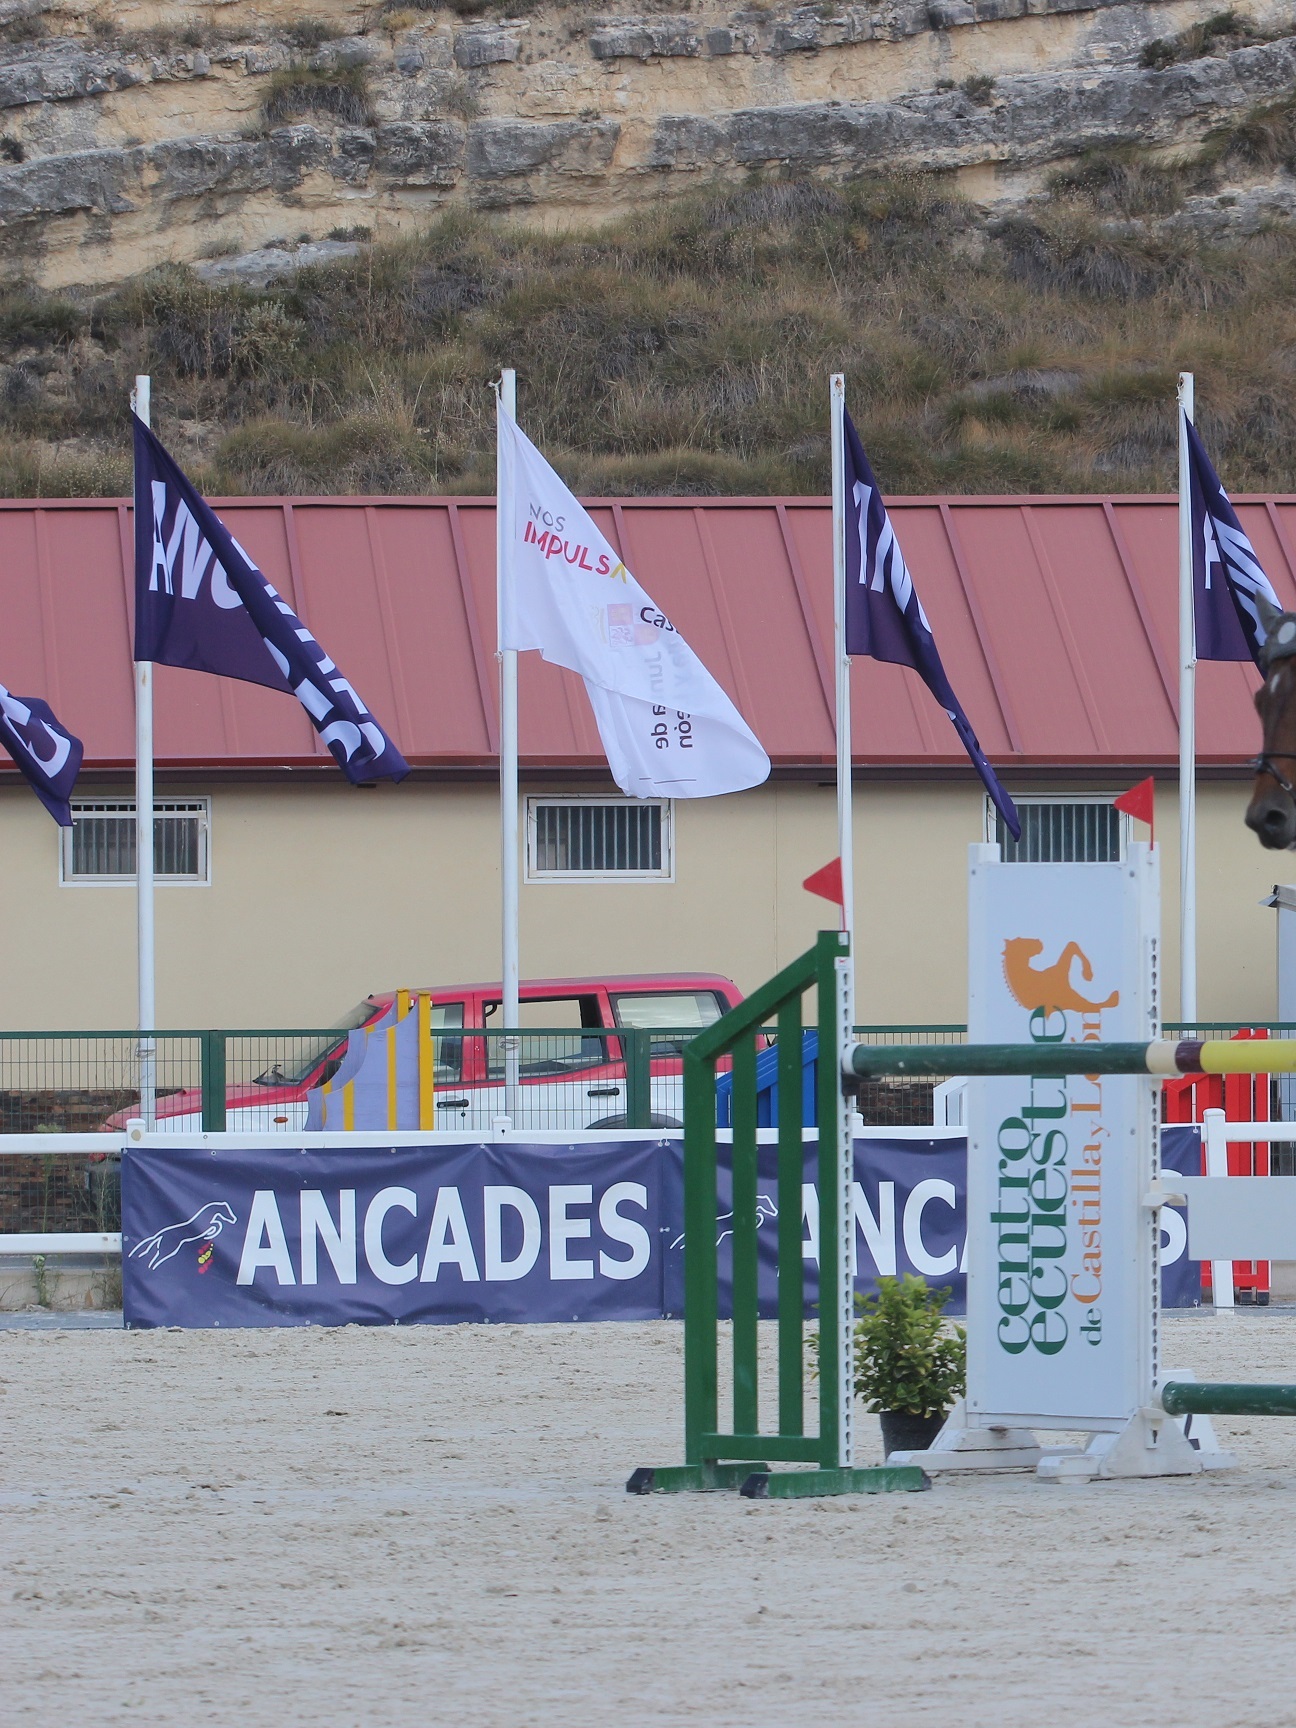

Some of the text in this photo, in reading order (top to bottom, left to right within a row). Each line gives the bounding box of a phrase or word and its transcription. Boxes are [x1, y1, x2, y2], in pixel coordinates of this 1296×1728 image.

[530, 502, 566, 532] NOS
[236, 1181, 651, 1285] ANCADES
[990, 1116, 1032, 1355] centro
[1021, 1005, 1069, 1355] ecueste
[1071, 1010, 1110, 1346] de Castilla y Ln
